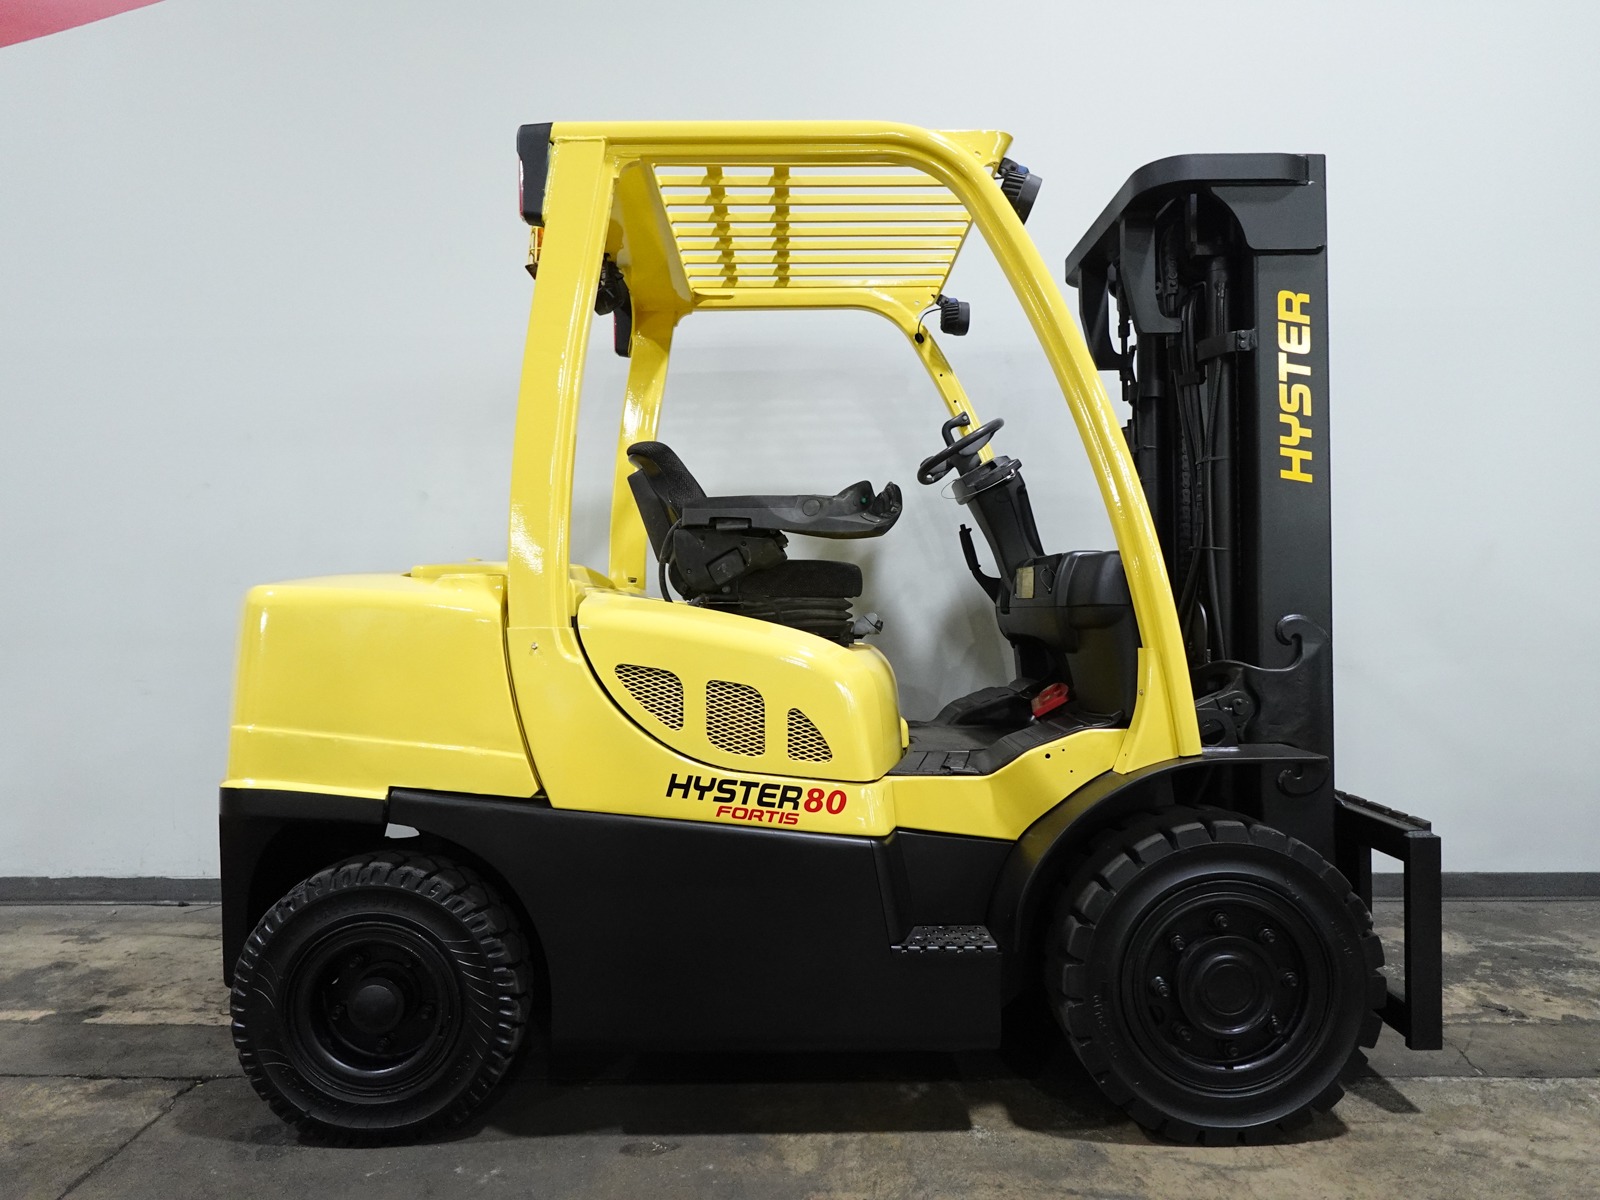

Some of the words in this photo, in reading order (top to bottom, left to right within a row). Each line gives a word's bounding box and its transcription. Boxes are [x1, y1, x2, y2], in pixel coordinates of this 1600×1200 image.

[1277, 289, 1313, 483] HYSTER
[665, 773, 803, 811] HYSTER
[803, 788, 847, 815] 80
[716, 805, 800, 825] FORTIS
